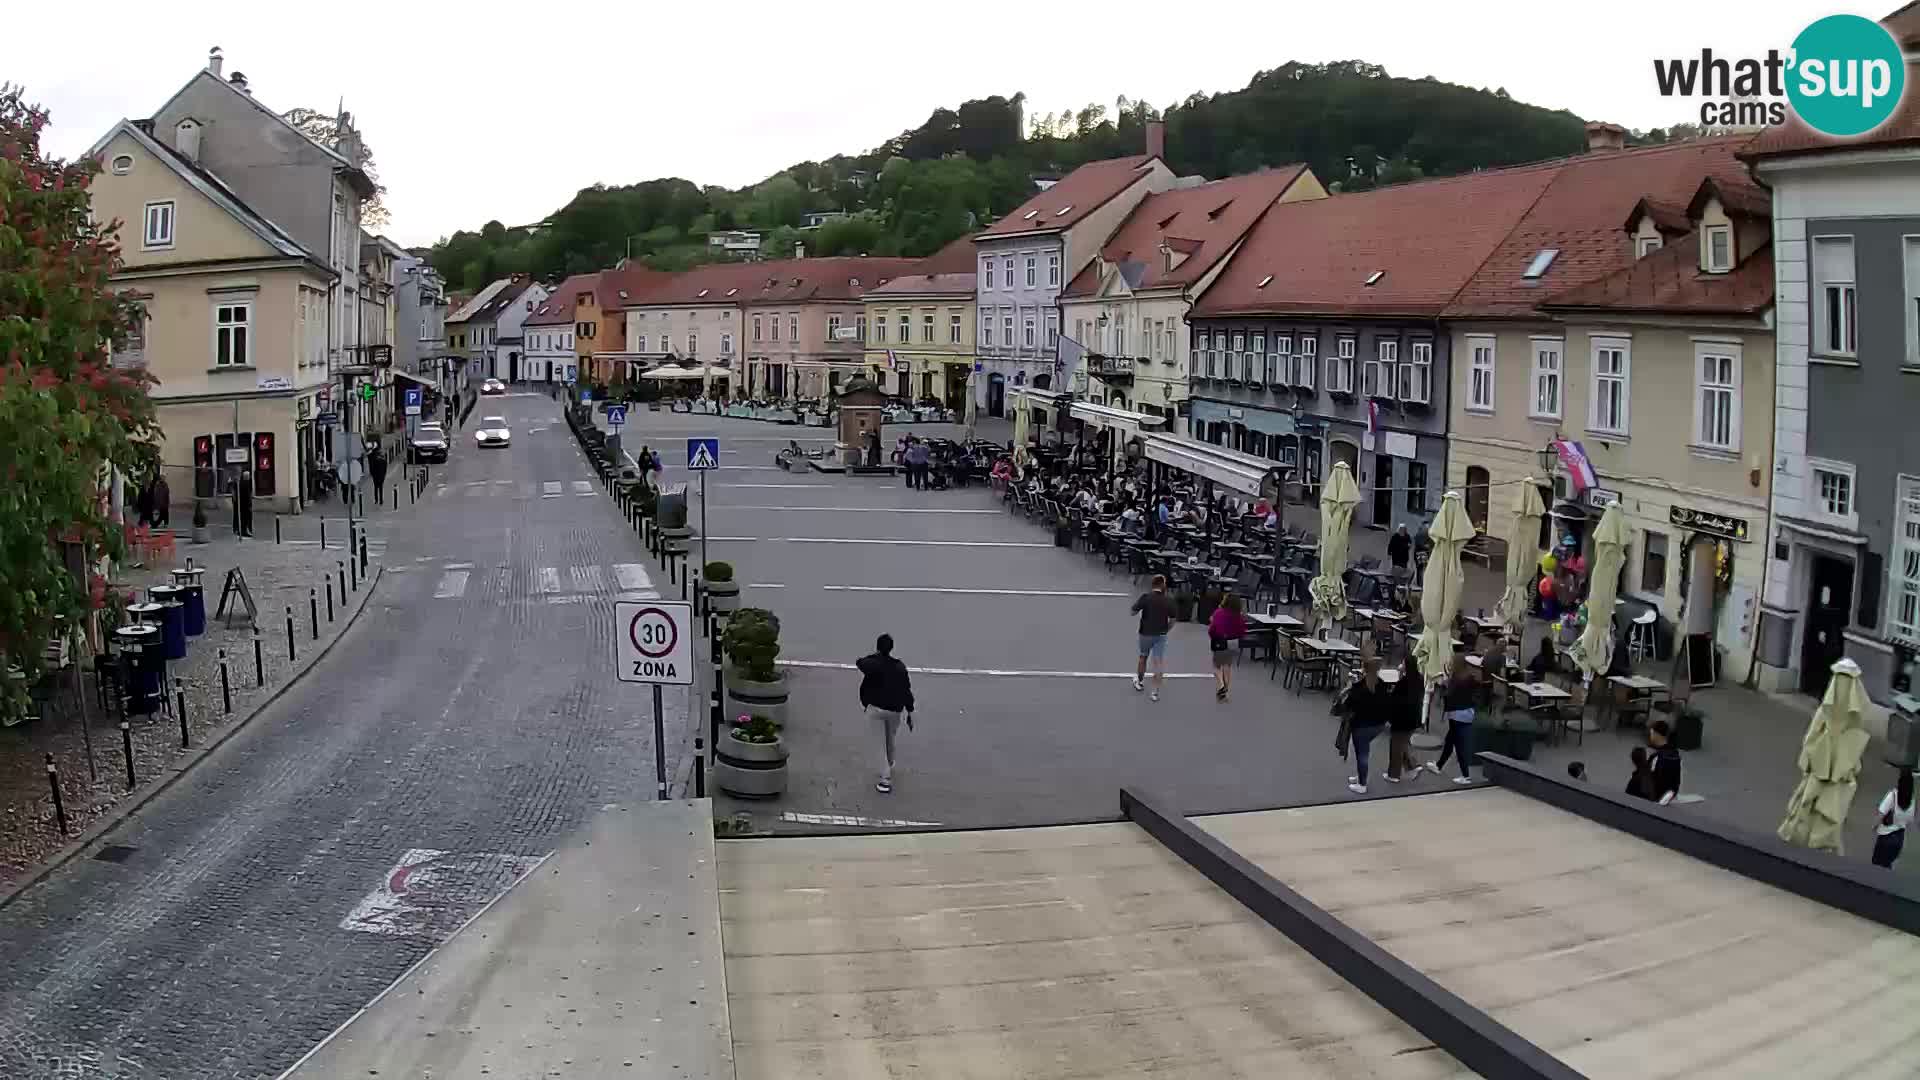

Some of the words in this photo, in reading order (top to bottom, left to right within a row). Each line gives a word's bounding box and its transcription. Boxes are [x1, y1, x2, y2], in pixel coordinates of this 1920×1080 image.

[409, 392, 417, 405] P
[642, 623, 666, 645] 30
[633, 660, 677, 678] ZONA
